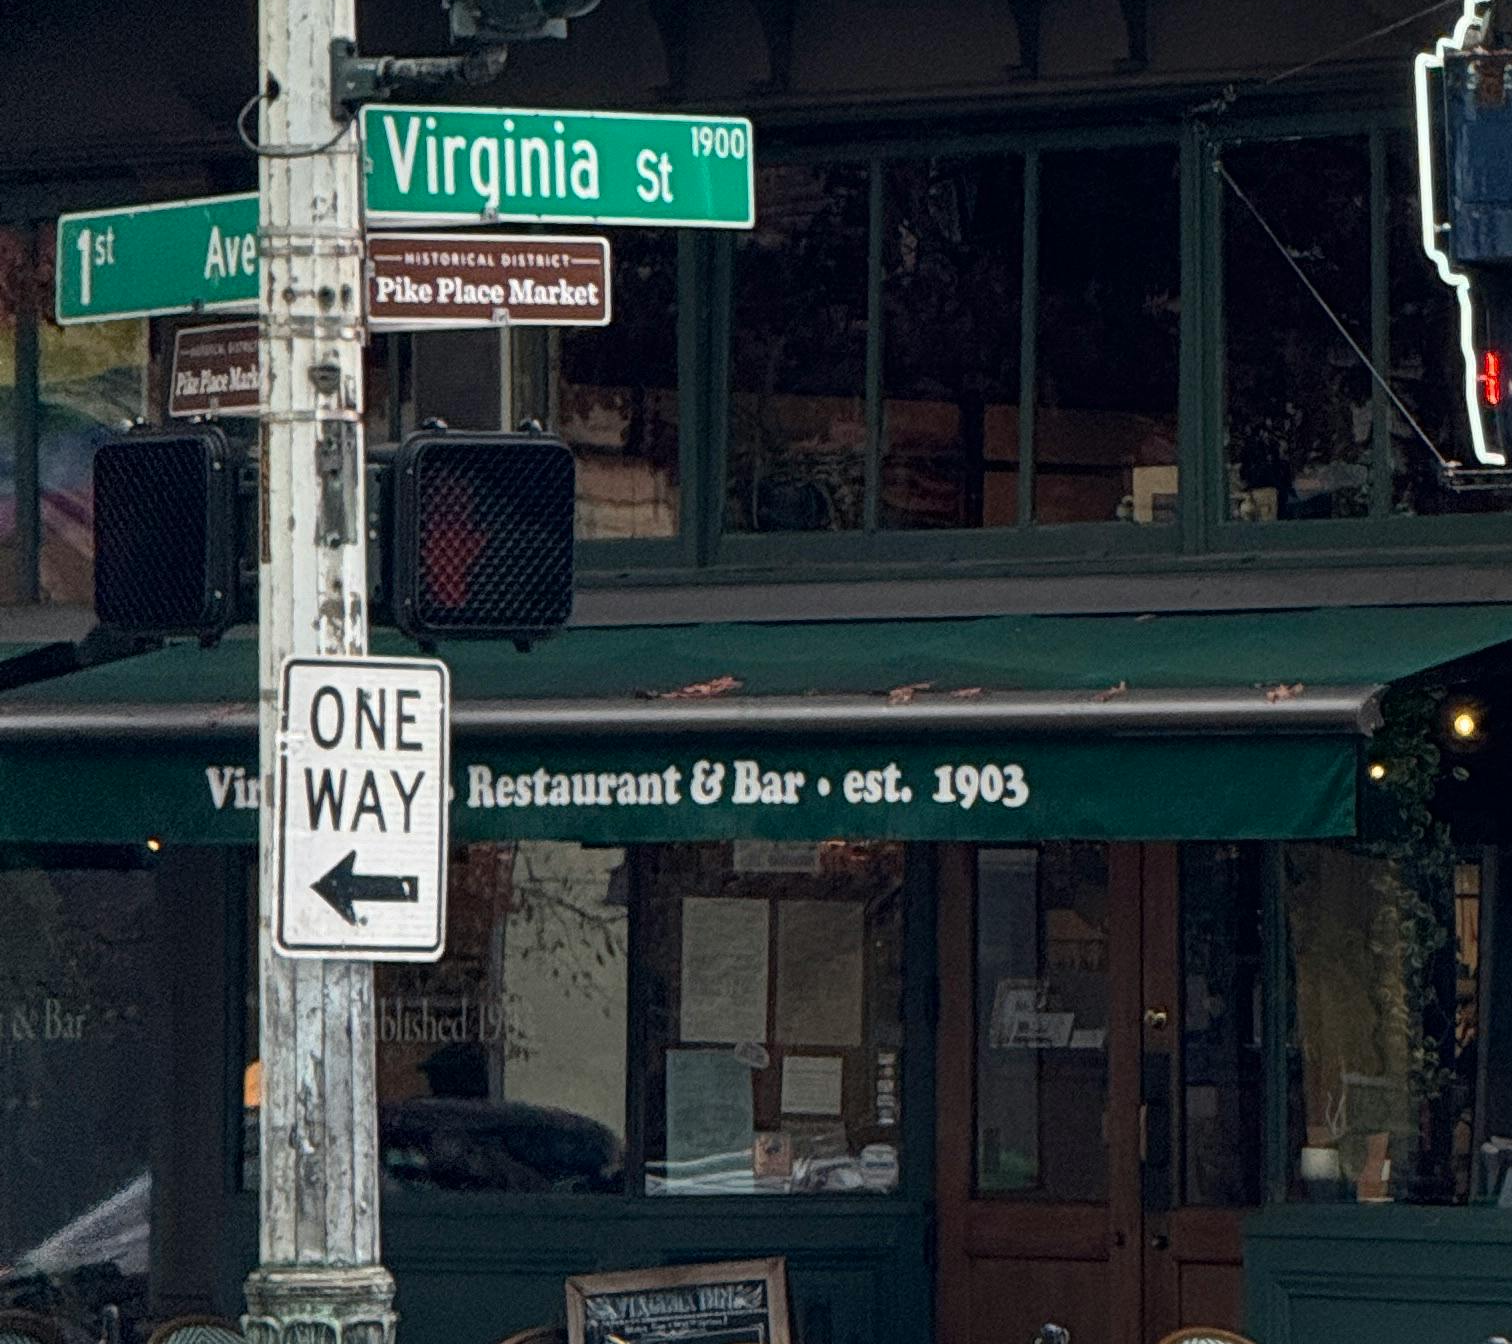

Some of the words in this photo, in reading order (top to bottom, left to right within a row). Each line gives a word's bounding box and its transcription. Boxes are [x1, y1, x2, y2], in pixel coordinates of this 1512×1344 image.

[383, 115, 600, 208] Virginia
[636, 148, 674, 204] St
[691, 126, 745, 160] 1900
[77, 225, 115, 306] 1st
[203, 225, 258, 280] Ave
[404, 251, 495, 268] HISTORICAL
[501, 253, 570, 270] DISTRICT
[376, 276, 433, 305] Pike
[436, 277, 505, 306] Place
[508, 278, 600, 308] Market
[310, 685, 423, 751] ONE
[304, 767, 426, 833] WAY
[467, 764, 683, 809] Restaurant
[690, 759, 726, 805] &
[731, 759, 805, 805] Bar
[843, 762, 913, 805] est.
[932, 763, 1030, 810] 1903
